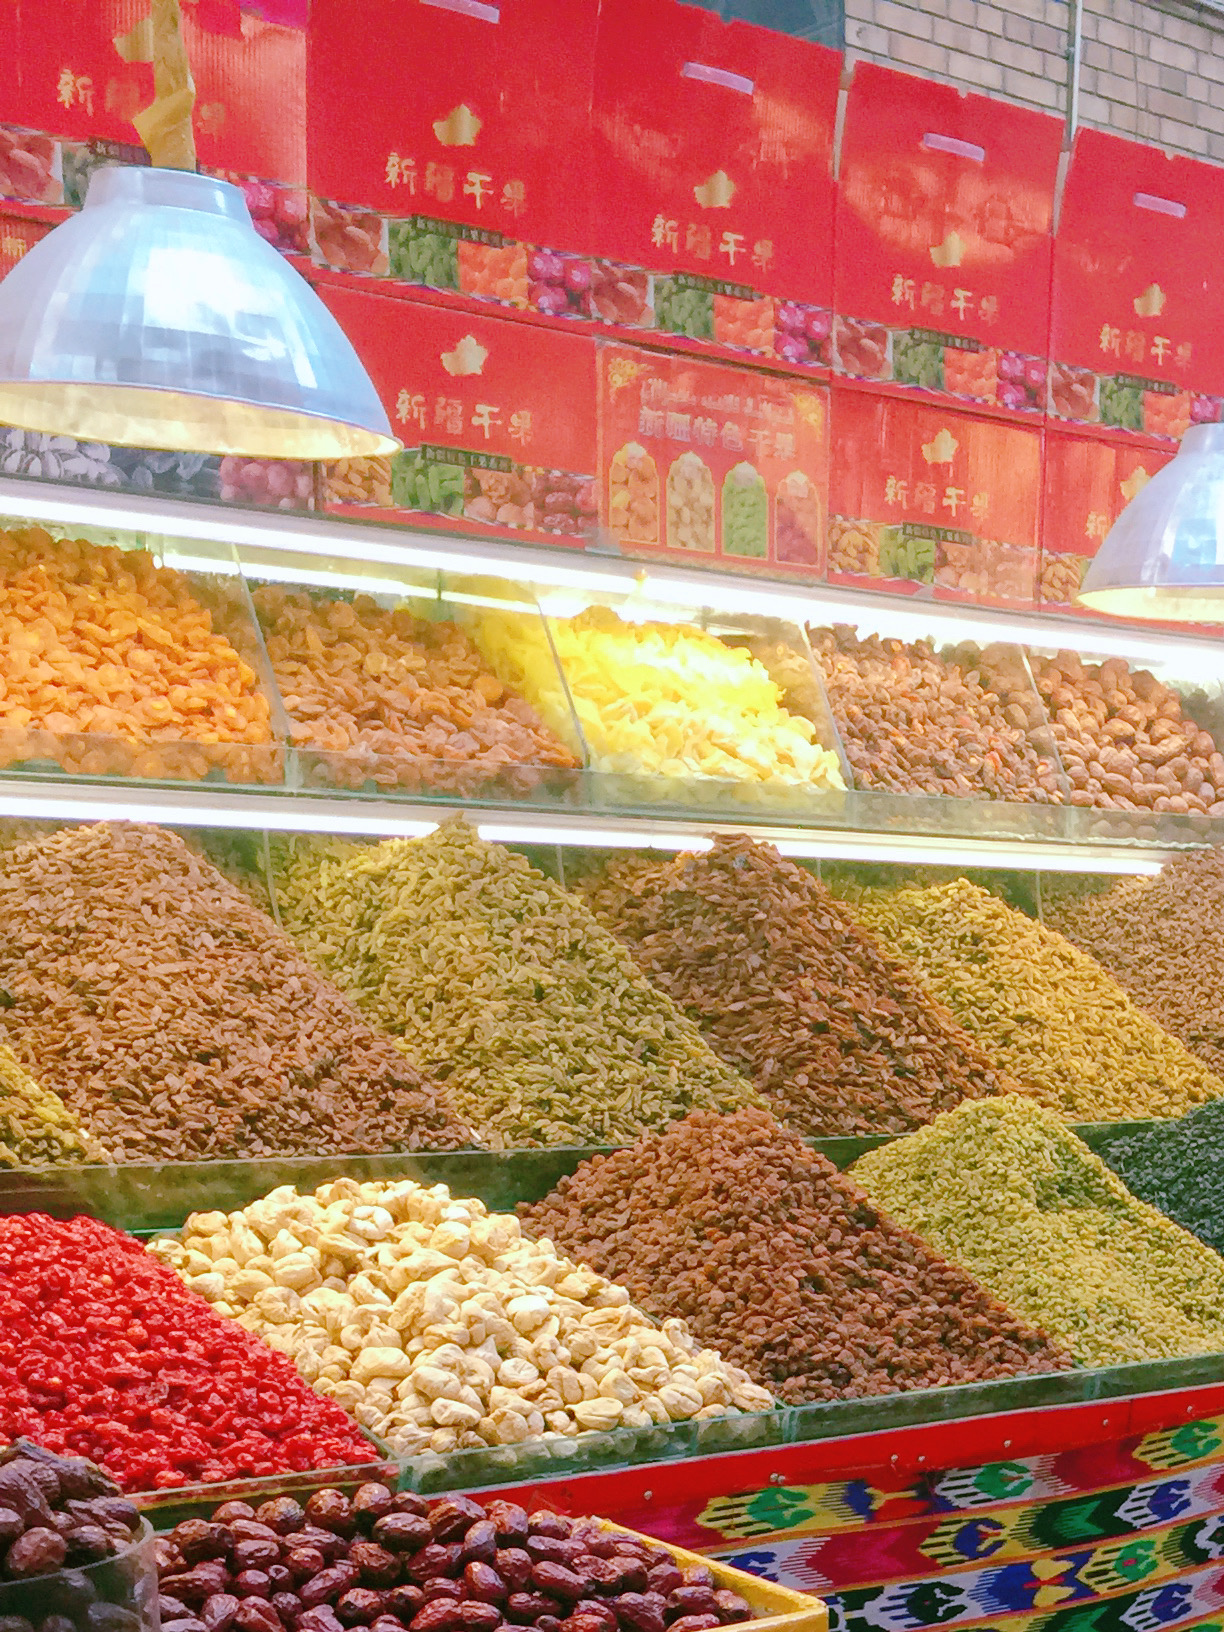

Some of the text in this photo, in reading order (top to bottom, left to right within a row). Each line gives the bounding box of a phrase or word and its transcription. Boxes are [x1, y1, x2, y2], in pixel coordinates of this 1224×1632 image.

[384, 152, 524, 217] 新疆干果
[651, 213, 772, 272] 新疆干果
[891, 273, 999, 326] 新疆干果
[1099, 323, 1192, 370] 新疆干果
[395, 389, 532, 446] 新疆干果
[884, 475, 990, 521] 新疆干果
